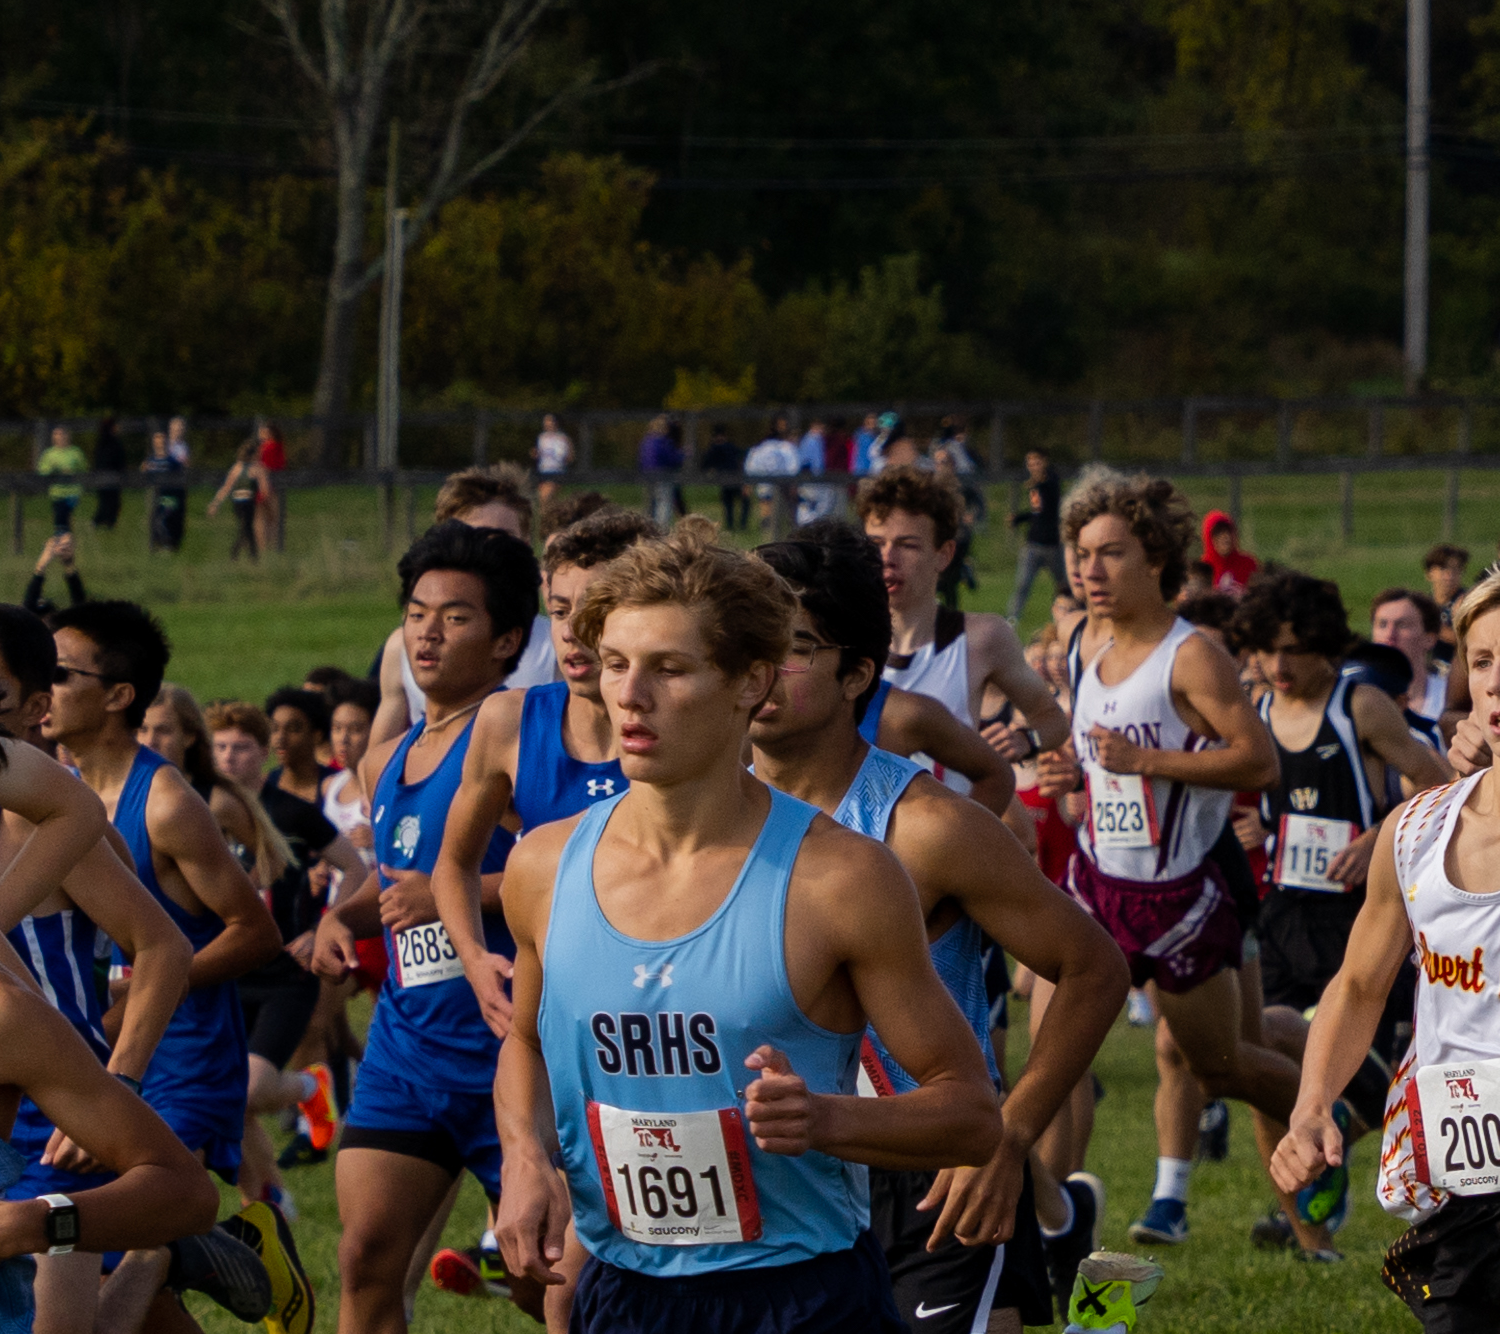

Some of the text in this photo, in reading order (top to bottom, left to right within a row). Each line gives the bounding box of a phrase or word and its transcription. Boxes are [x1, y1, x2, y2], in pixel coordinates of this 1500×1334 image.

[1096, 801, 1144, 832] 2523
[1290, 844, 1338, 876] 115
[400, 926, 458, 969] 2683
[590, 1010, 722, 1077] SRHS
[631, 1118, 677, 1128] MARYLAND
[616, 1163, 727, 1219] 1691
[1460, 1175, 1499, 1188] saucony
[647, 1224, 700, 1237] saucony
